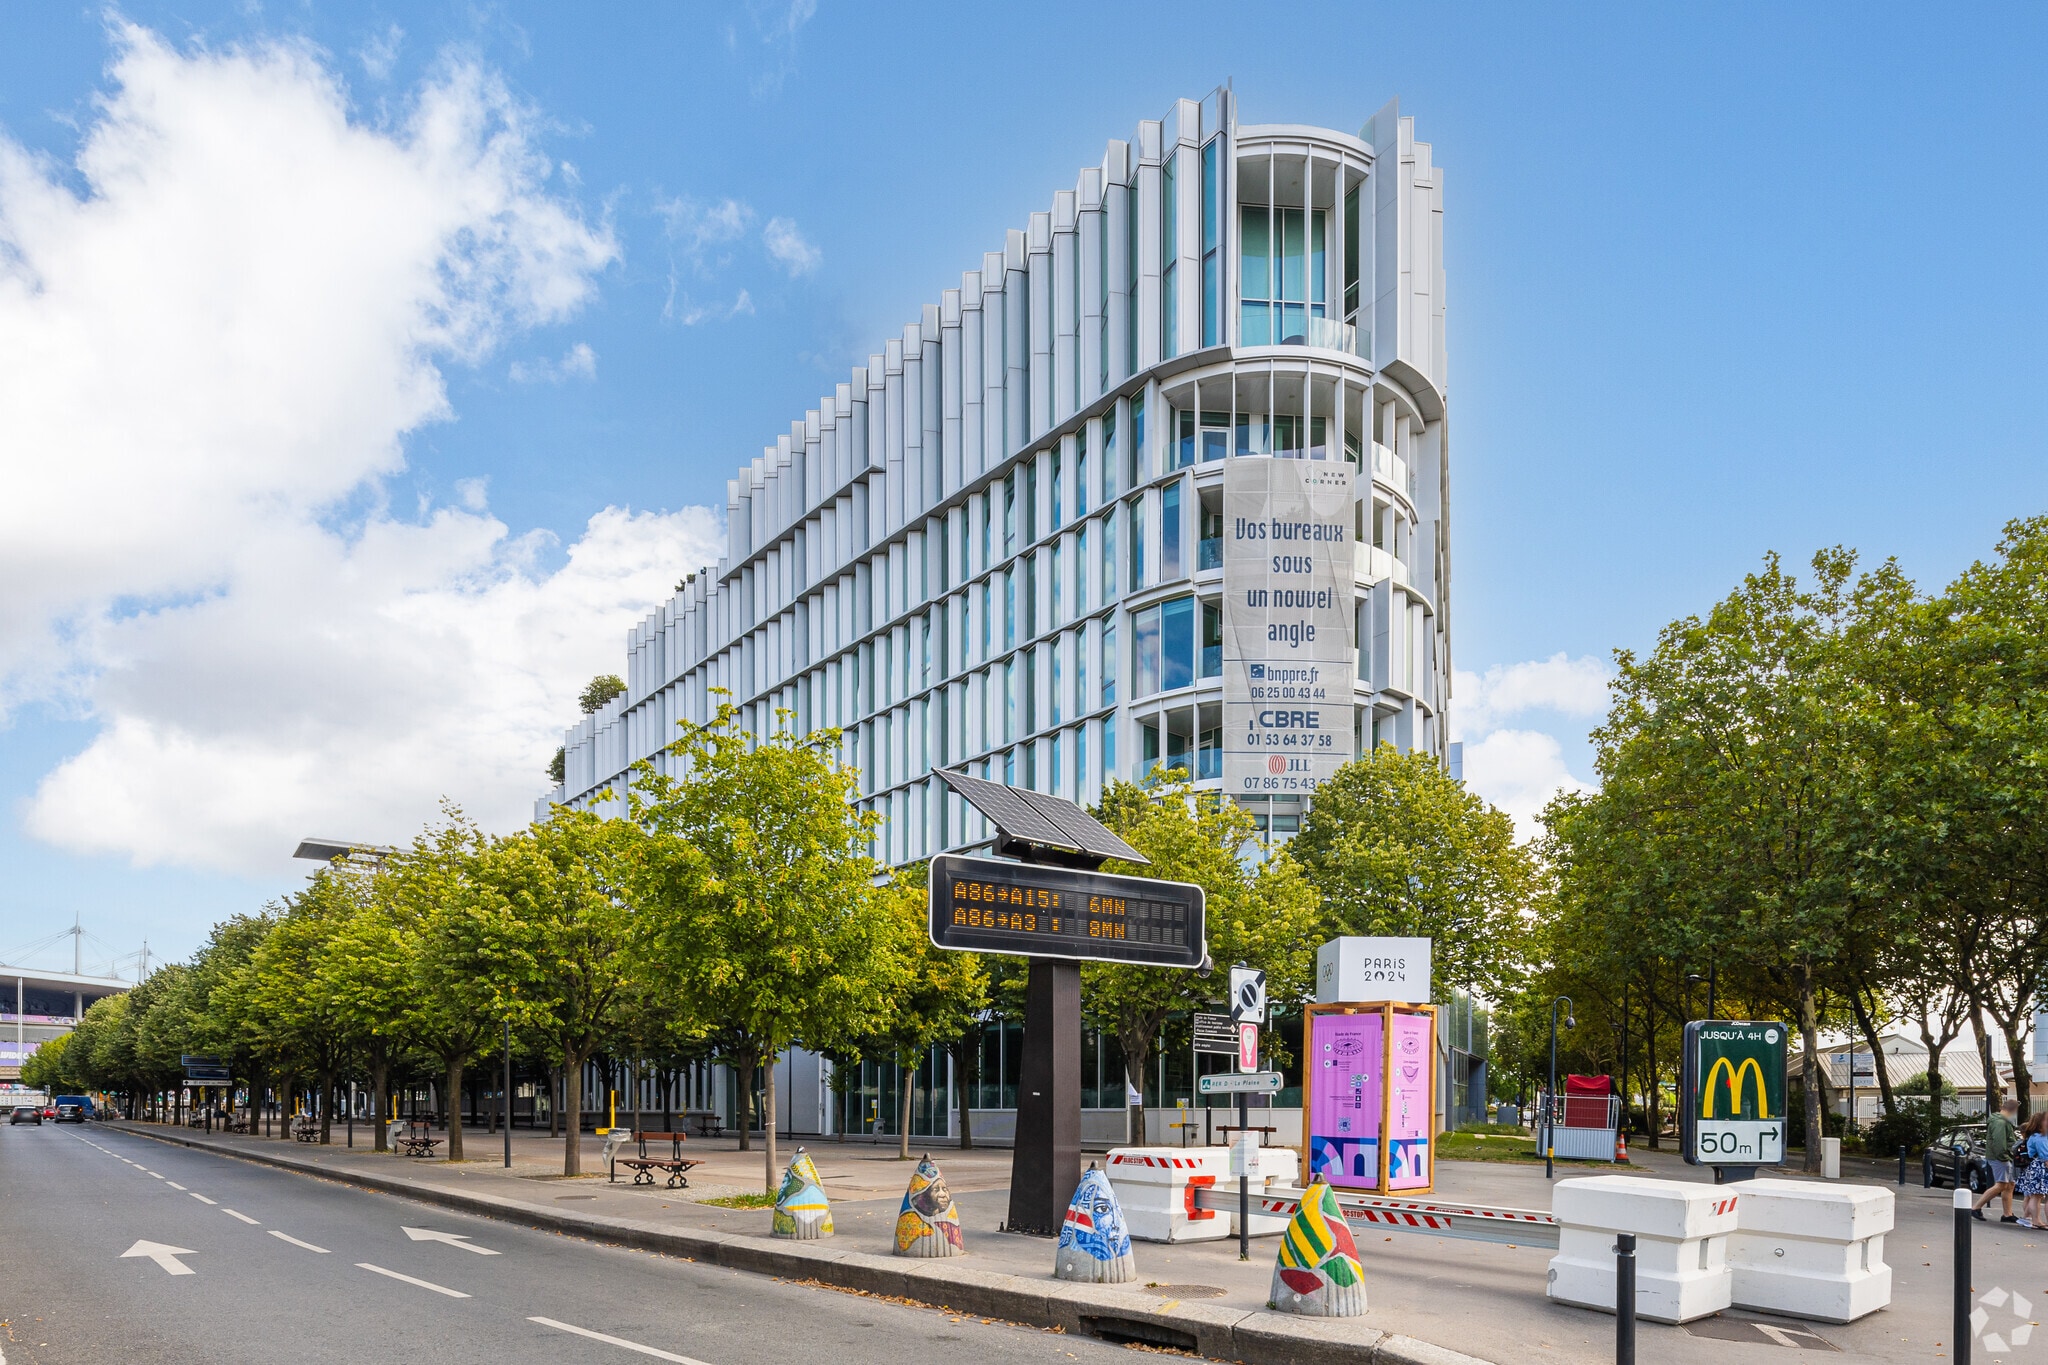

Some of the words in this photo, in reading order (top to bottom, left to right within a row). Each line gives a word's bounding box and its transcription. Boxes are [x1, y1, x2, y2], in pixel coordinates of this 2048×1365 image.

[1304, 478, 1347, 486] CORNER
[1235, 517, 1267, 540] Vos
[1272, 517, 1344, 543] bureaux
[1272, 555, 1312, 574] sous
[1247, 589, 1268, 608] un
[1273, 587, 1332, 609] nouvel
[1268, 620, 1316, 649] angle
[1267, 666, 1319, 684] bnppre.fr
[1251, 687, 1264, 699] 06
[1267, 687, 1280, 699] 25
[1282, 687, 1295, 699] 00
[1298, 687, 1311, 699] 43
[1313, 688, 1326, 700] 44
[1258, 710, 1320, 729] CBRE
[1247, 733, 1260, 746] 01
[1265, 734, 1279, 746] 53
[1282, 734, 1297, 746] 64
[1300, 734, 1315, 746] 37
[1318, 735, 1332, 747] 58
[1287, 758, 1312, 772] JLL
[1244, 777, 1260, 789] 07
[1263, 777, 1279, 789] 86
[1282, 777, 1298, 789] 75
[1300, 777, 1316, 789] 43
[1089, 896, 1125, 916] 6MN
[1089, 920, 1125, 940] 8MN
[1364, 970, 1406, 982] 2024
[1700, 1030, 1744, 1041] JUSQU'À
[1747, 1032, 1762, 1041] 4H
[1133, 1157, 1144, 1165] STOP
[1350, 1210, 1364, 1219] STOP
